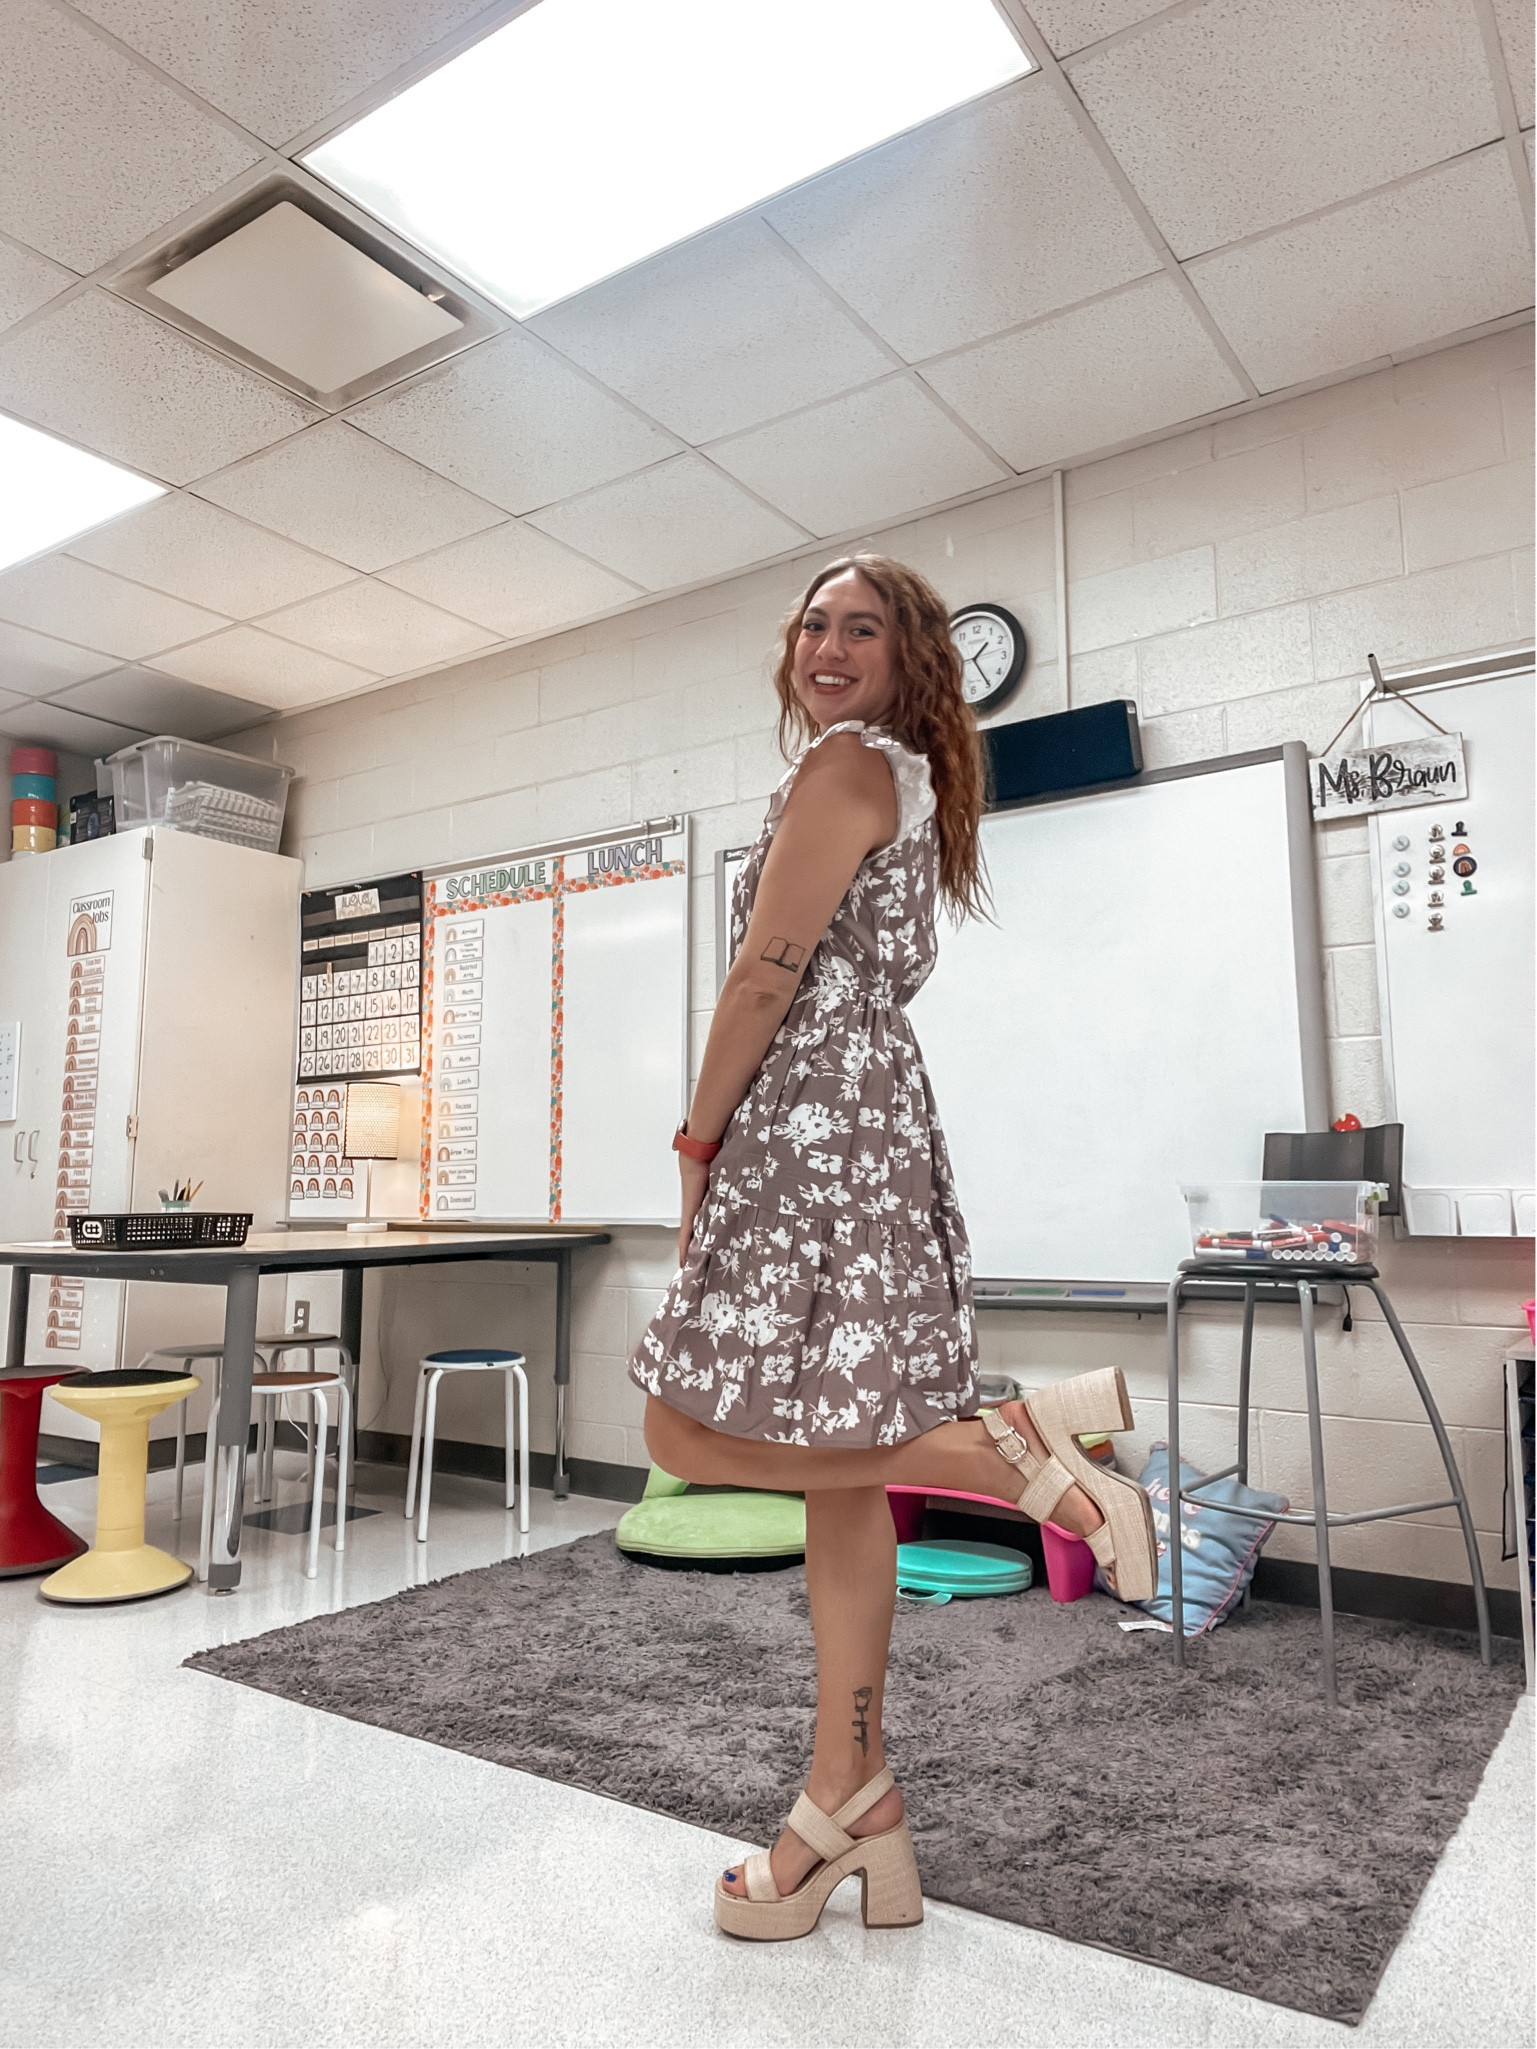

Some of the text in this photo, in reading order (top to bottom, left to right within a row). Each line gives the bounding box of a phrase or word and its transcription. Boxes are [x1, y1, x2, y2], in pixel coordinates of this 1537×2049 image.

[958, 632, 966, 641] 11
[972, 625, 981, 634] 12
[988, 627, 993, 635] 1
[997, 635, 1004, 644] 2
[1001, 651, 1007, 660] 3
[995, 667, 1002, 675] 4
[970, 686, 976, 695] 6
[1368, 753, 1456, 800] Braun
[588, 838, 662, 875] LUNCH
[446, 861, 546, 899] SCHEDULE
[72, 897, 111, 914] Classroom
[90, 911, 109, 925] Jobs
[390, 944, 397, 959] 2
[408, 941, 414, 955] 3
[307, 966, 415, 994] 4 5 6 7 8 9 10
[306, 994, 414, 1022] 11 12 13 14 15 16 17
[305, 1021, 417, 1047] 18 19 20 21 22 23 24
[303, 1047, 415, 1073] 25 26 27 28 29 30 31
